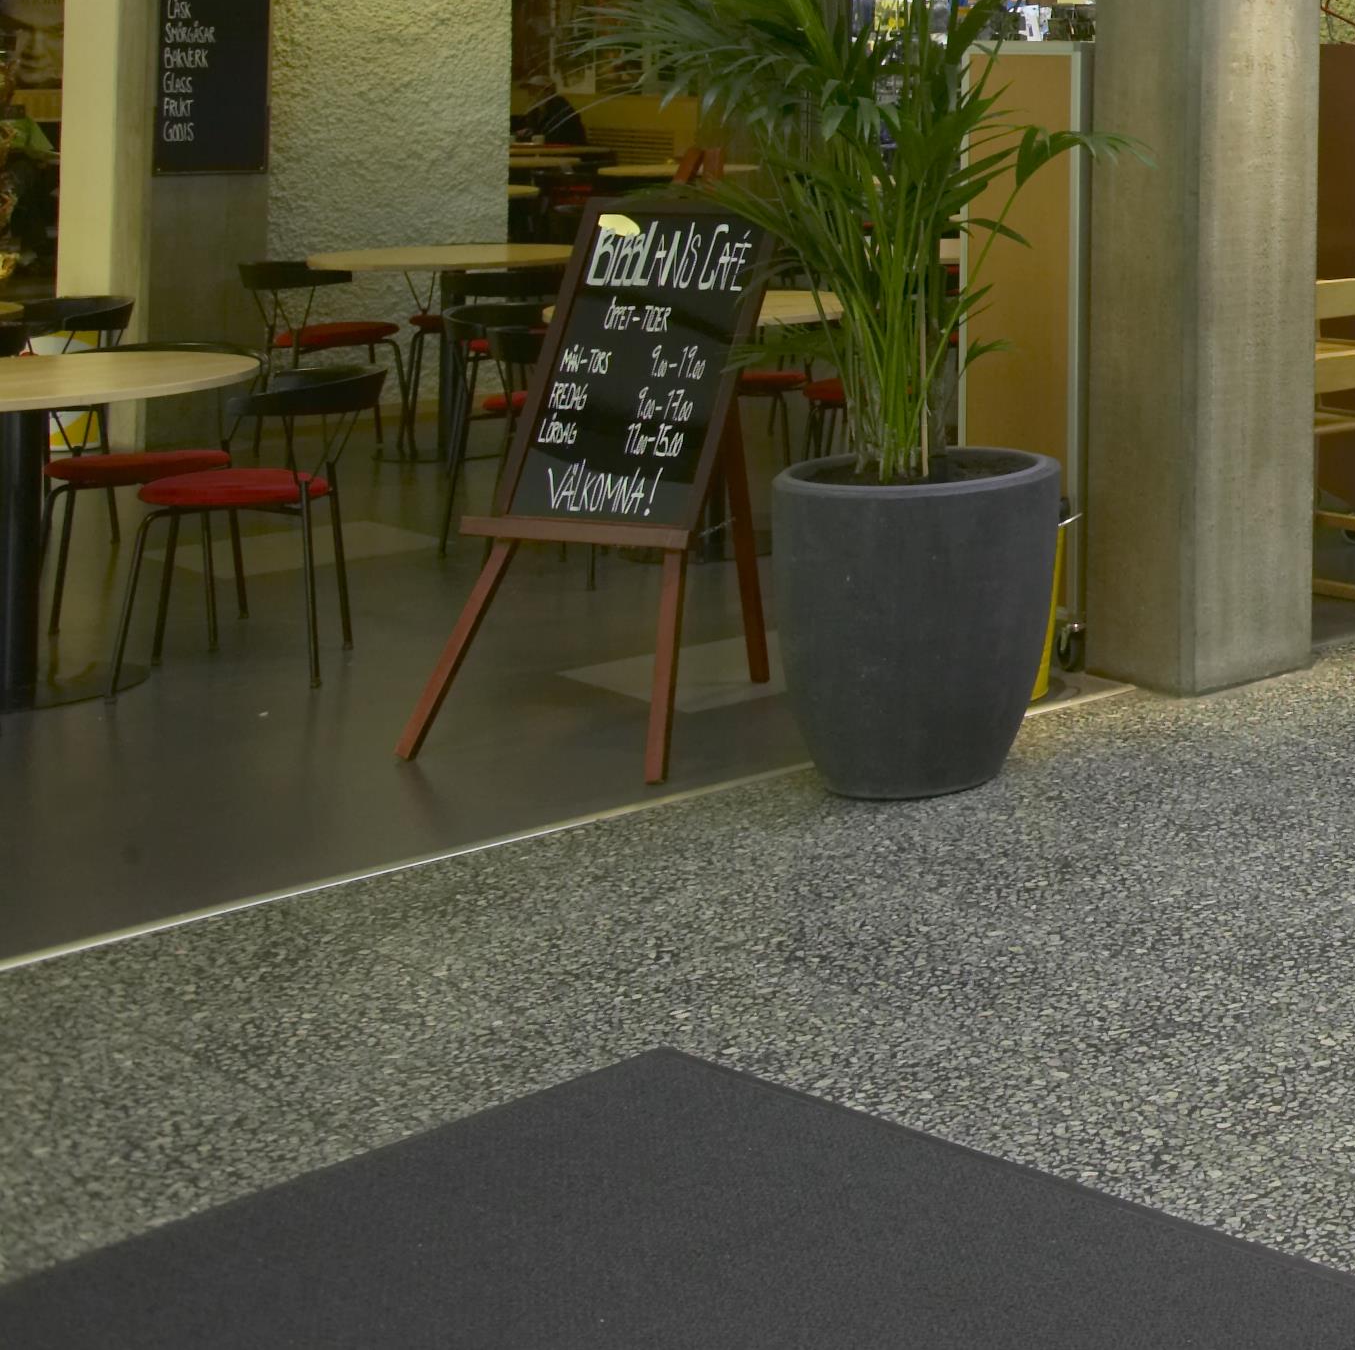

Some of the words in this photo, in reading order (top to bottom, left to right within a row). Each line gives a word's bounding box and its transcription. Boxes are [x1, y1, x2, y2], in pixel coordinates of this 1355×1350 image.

[164, 20, 216, 44] SMÖRGÅSAR
[163, 47, 209, 69] BAKVERK
[162, 71, 193, 94] GLASS
[162, 97, 195, 117] FRUKT
[162, 121, 195, 142] GODIS
[586, 220, 702, 290] BIBBLANS
[698, 223, 753, 292] CAFÉ
[548, 381, 589, 411] FREDAG
[537, 412, 578, 445] LÖRDAG
